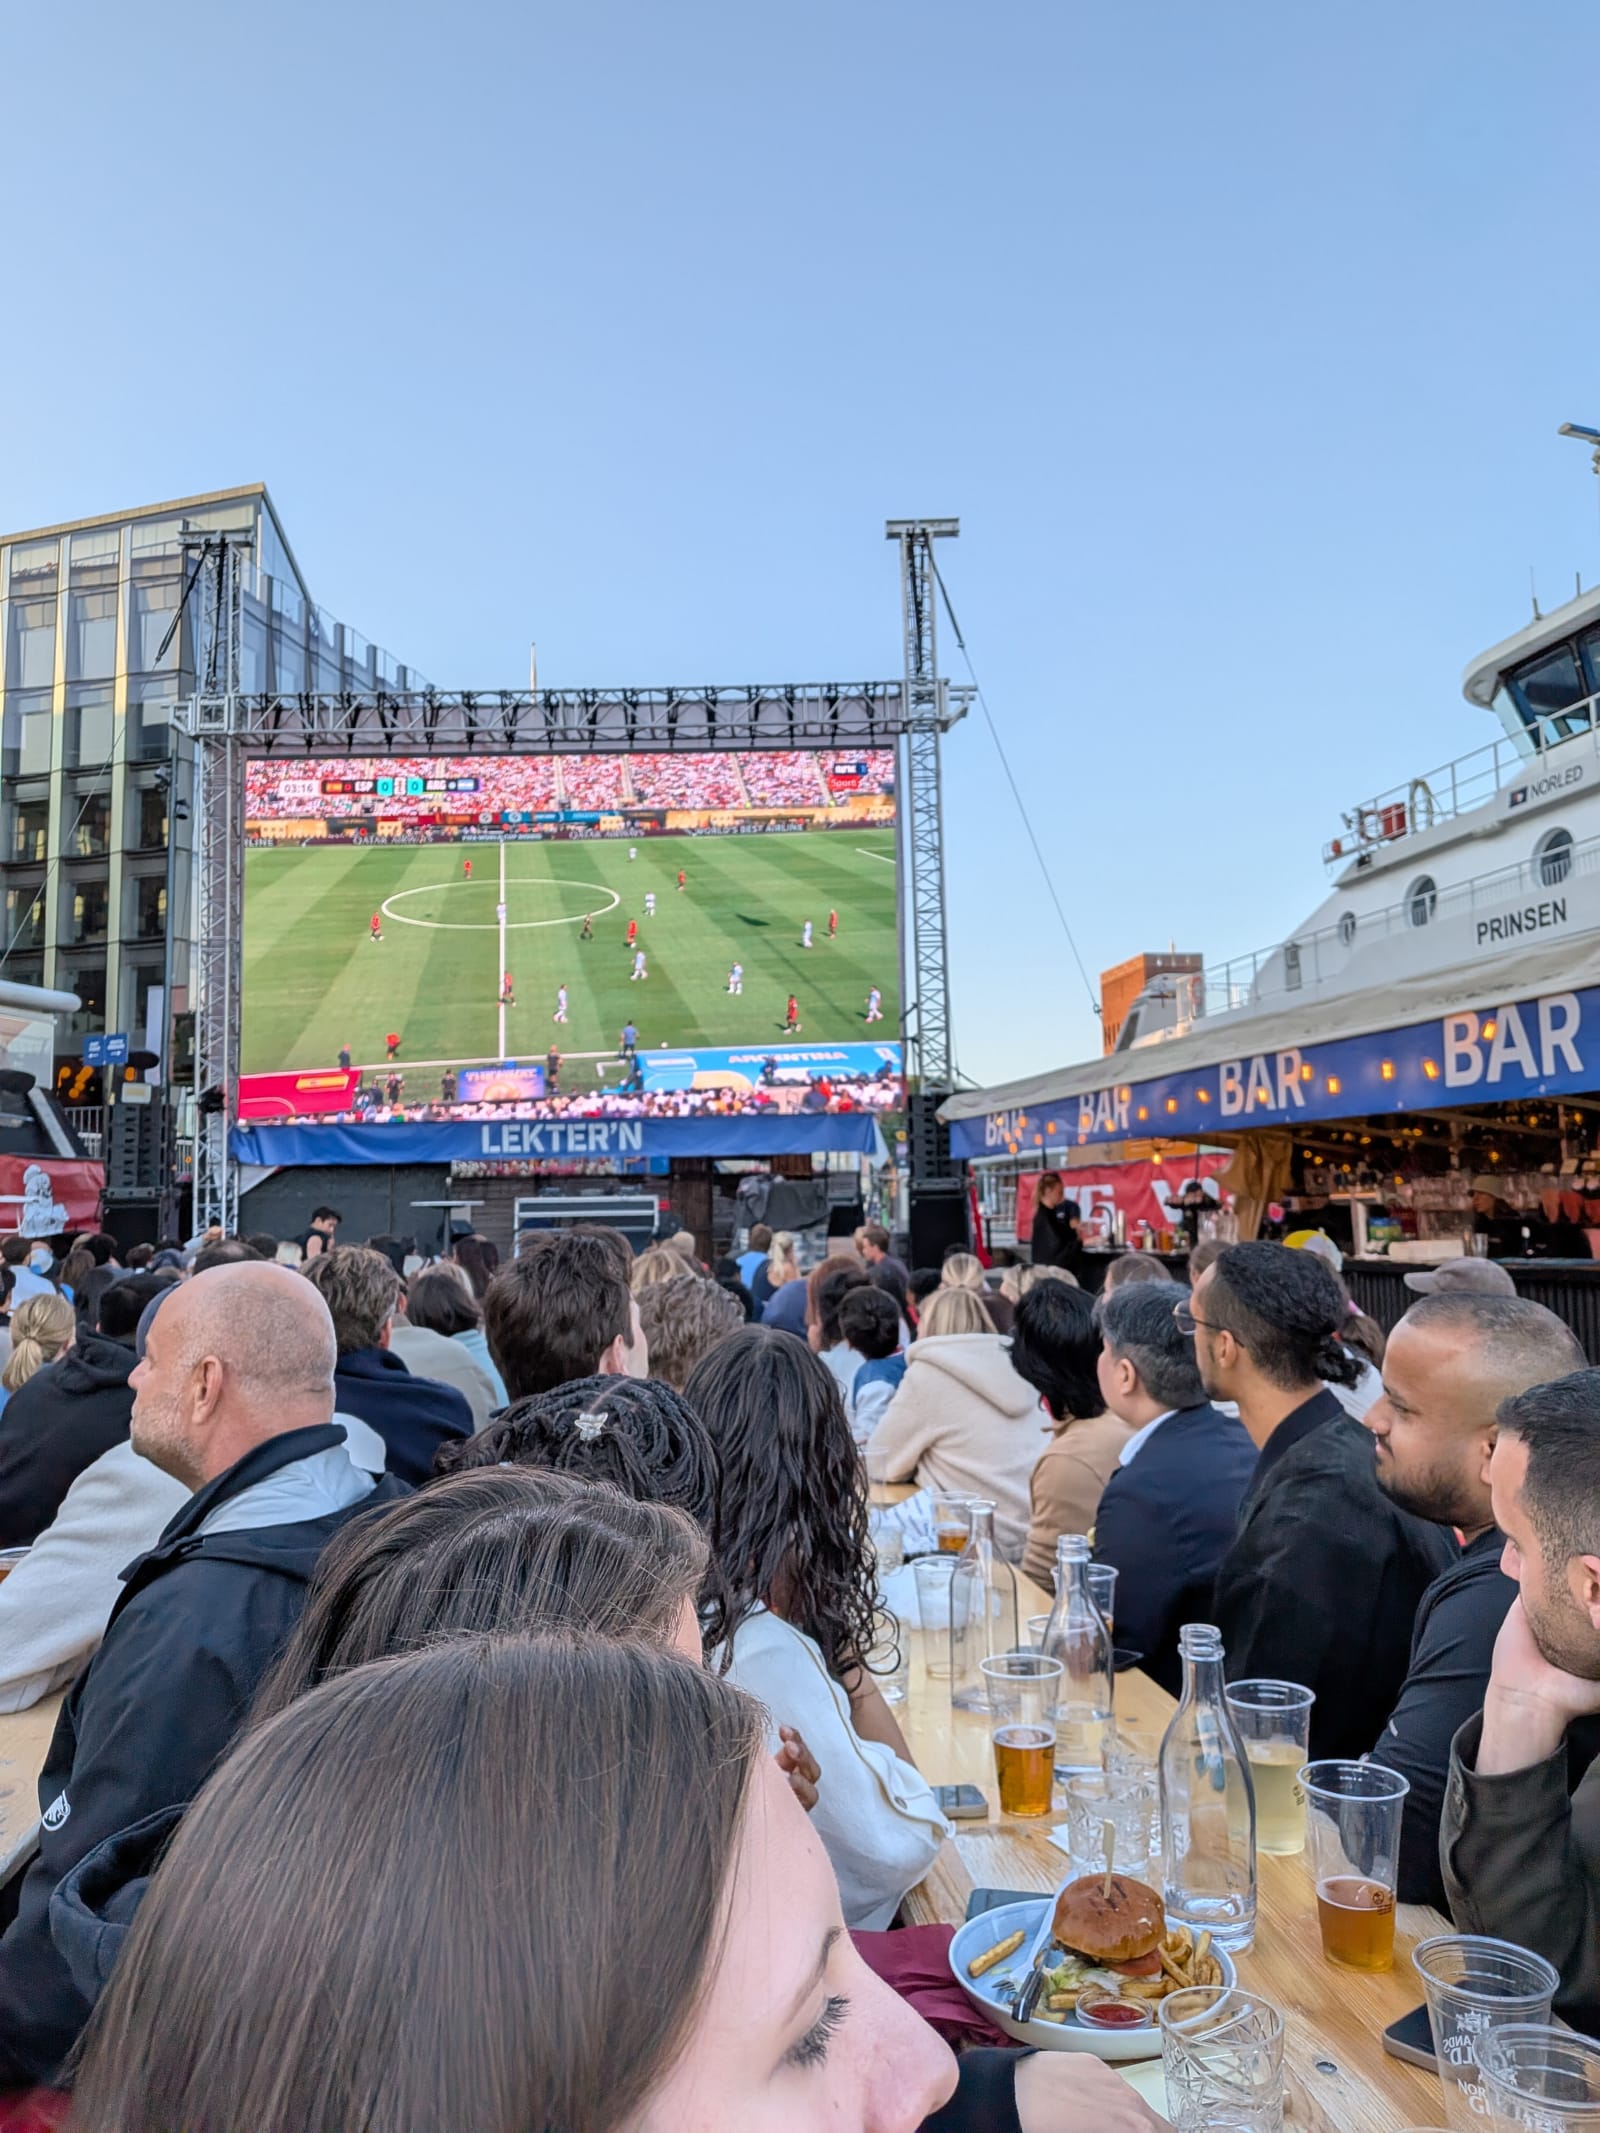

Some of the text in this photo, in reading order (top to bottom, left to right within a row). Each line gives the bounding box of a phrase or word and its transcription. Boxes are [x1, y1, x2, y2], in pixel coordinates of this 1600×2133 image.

[284, 783, 313, 793] 03:16
[382, 782, 389, 792] 0
[411, 781, 419, 791] 0
[831, 778, 857, 788] Sport
[1531, 765, 1584, 797] NORLED
[1476, 897, 1567, 945] PRINSEN
[1443, 992, 1584, 1088] BAR
[1219, 1047, 1305, 1117] BAR
[1078, 1086, 1132, 1134] BAR
[481, 1121, 643, 1154] LEKTER'N
